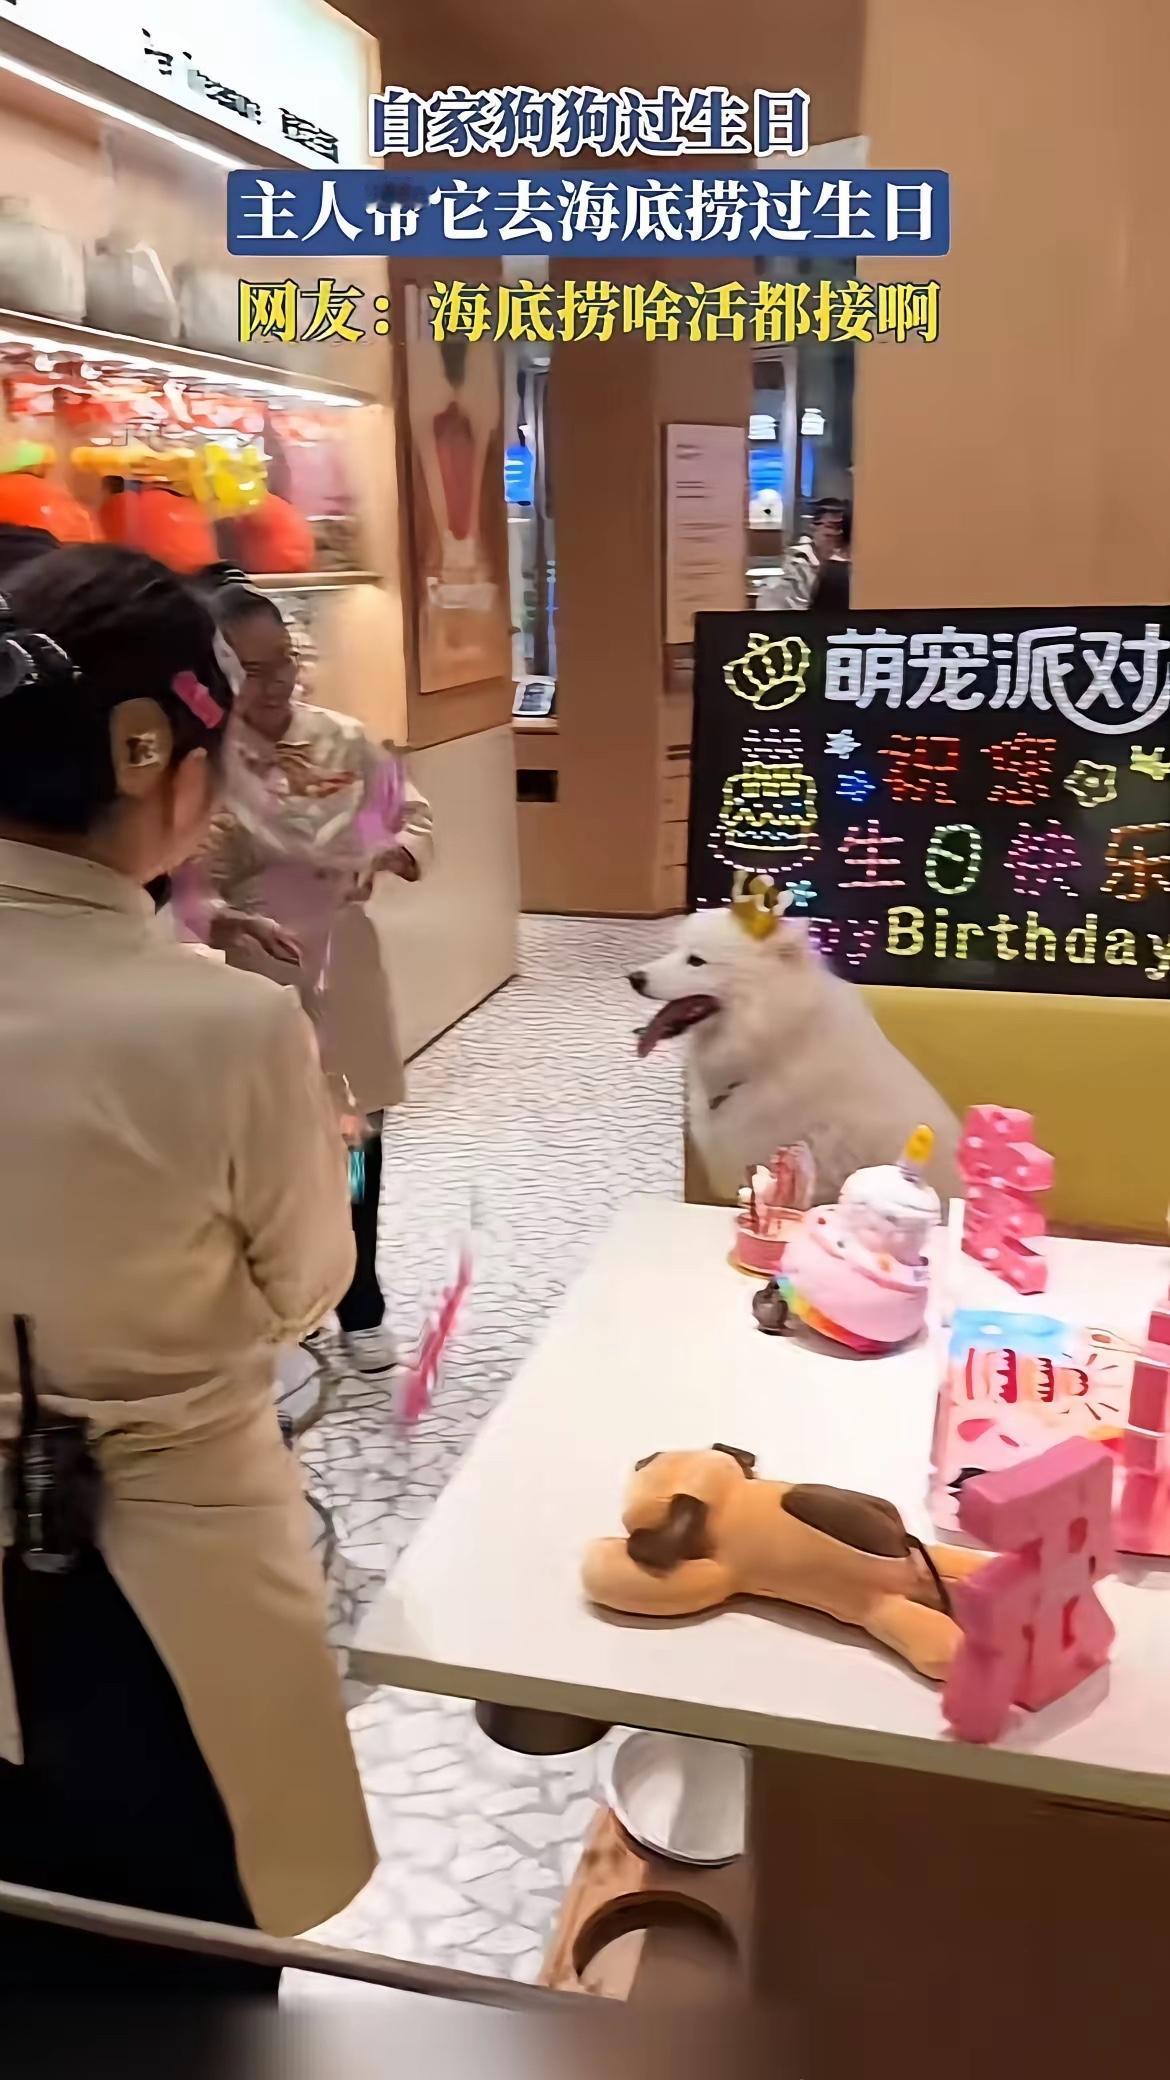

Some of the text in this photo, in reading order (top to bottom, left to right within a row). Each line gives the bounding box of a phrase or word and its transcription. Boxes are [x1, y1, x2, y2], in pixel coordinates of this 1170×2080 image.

[824, 623, 1170, 722] 萌宠派对
[837, 818, 1170, 900] 生日快乐
[885, 905, 1170, 980] Birthday
